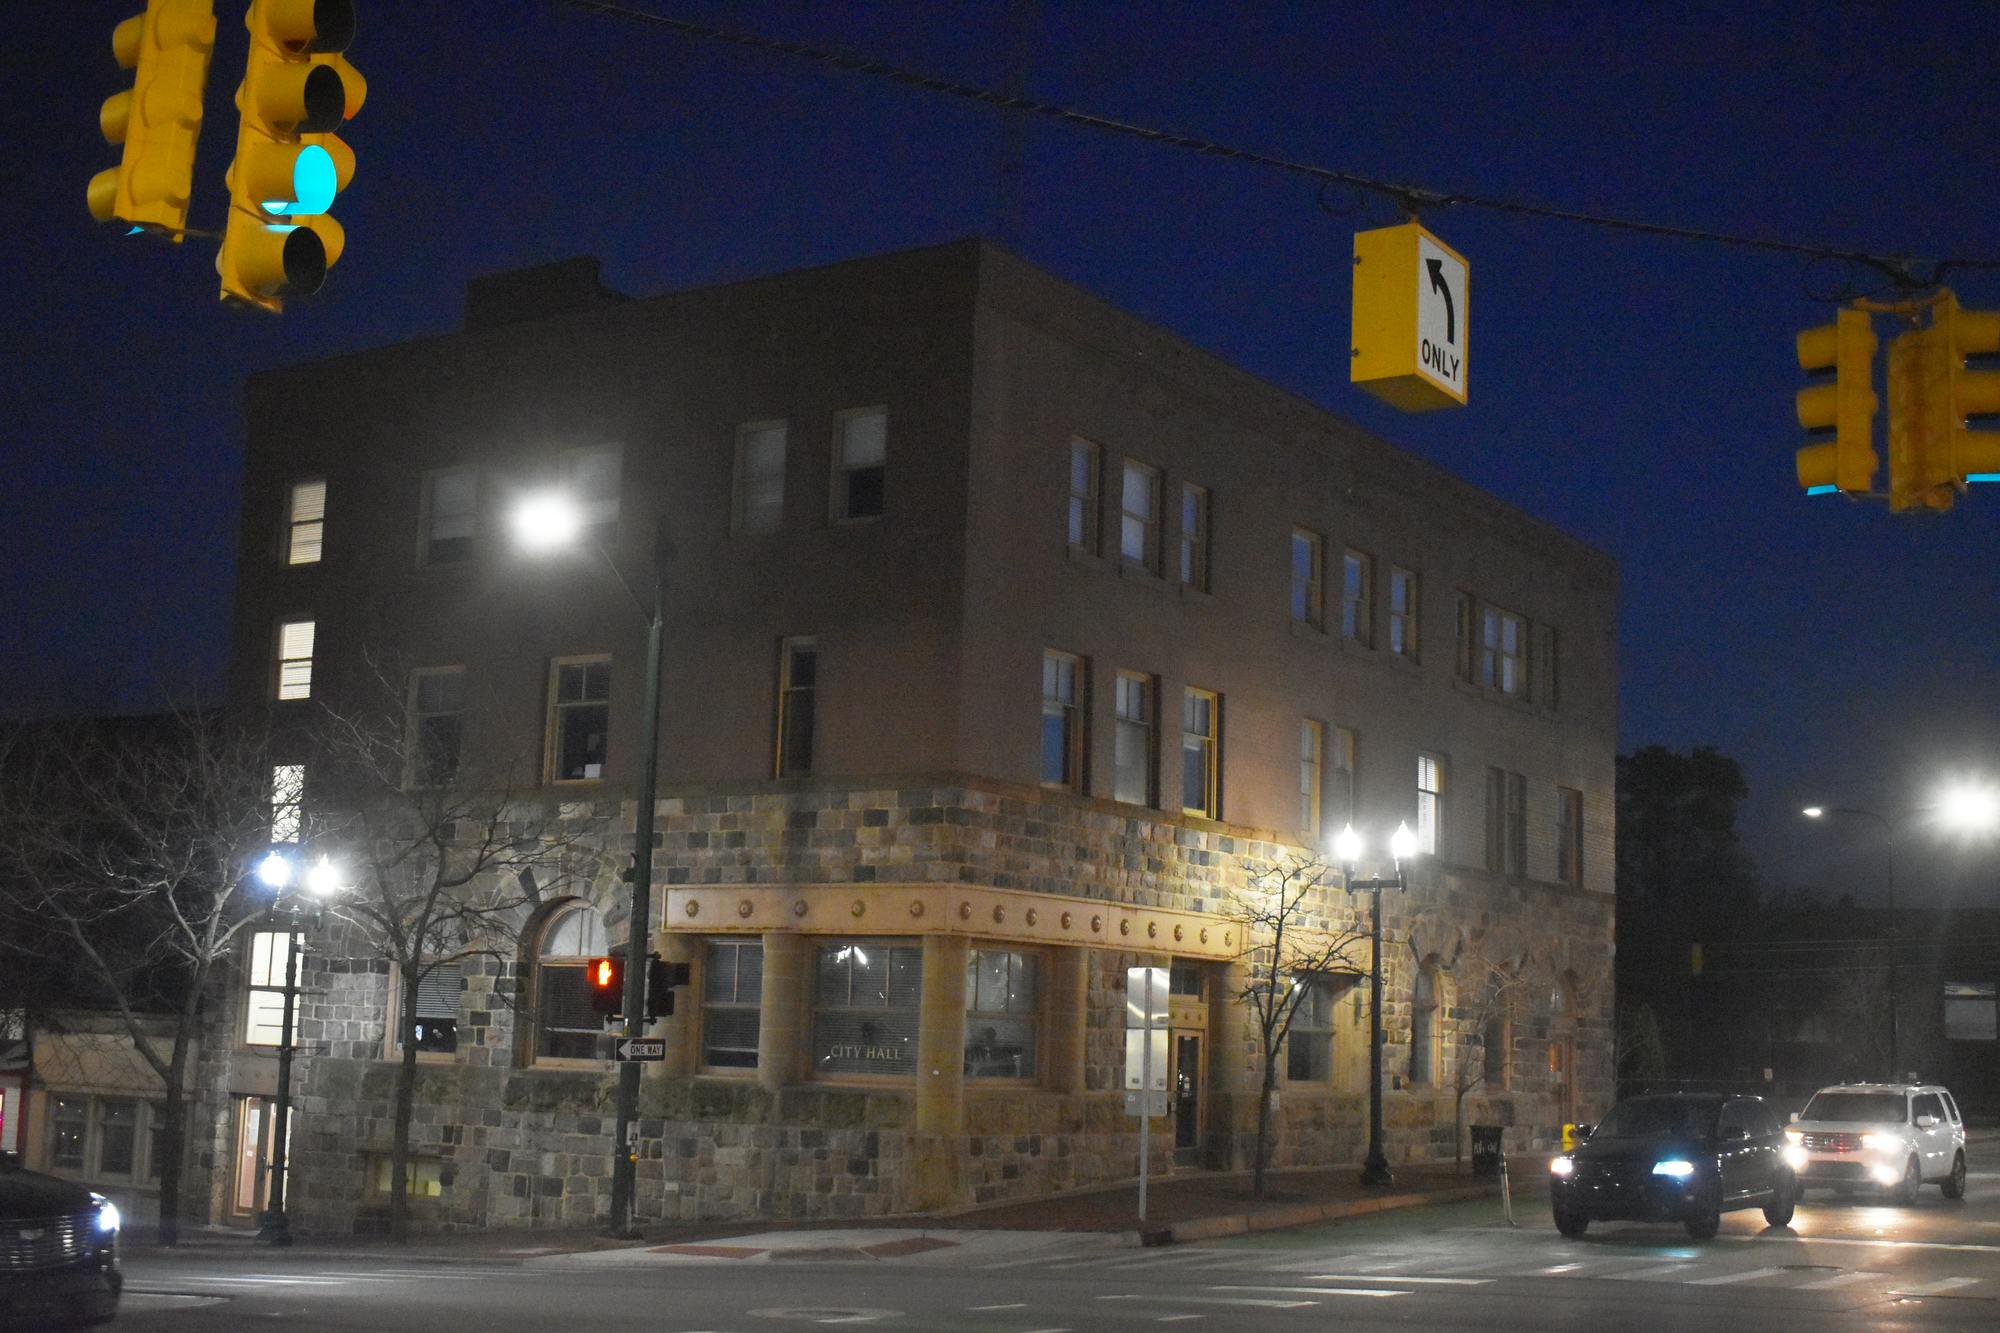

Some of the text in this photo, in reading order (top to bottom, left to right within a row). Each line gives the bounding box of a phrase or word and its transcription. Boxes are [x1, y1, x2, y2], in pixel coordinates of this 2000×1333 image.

[1421, 338, 1460, 383] ONLY
[630, 1045, 661, 1055] ONE WAY
[830, 1044, 902, 1060] CITY HALL
